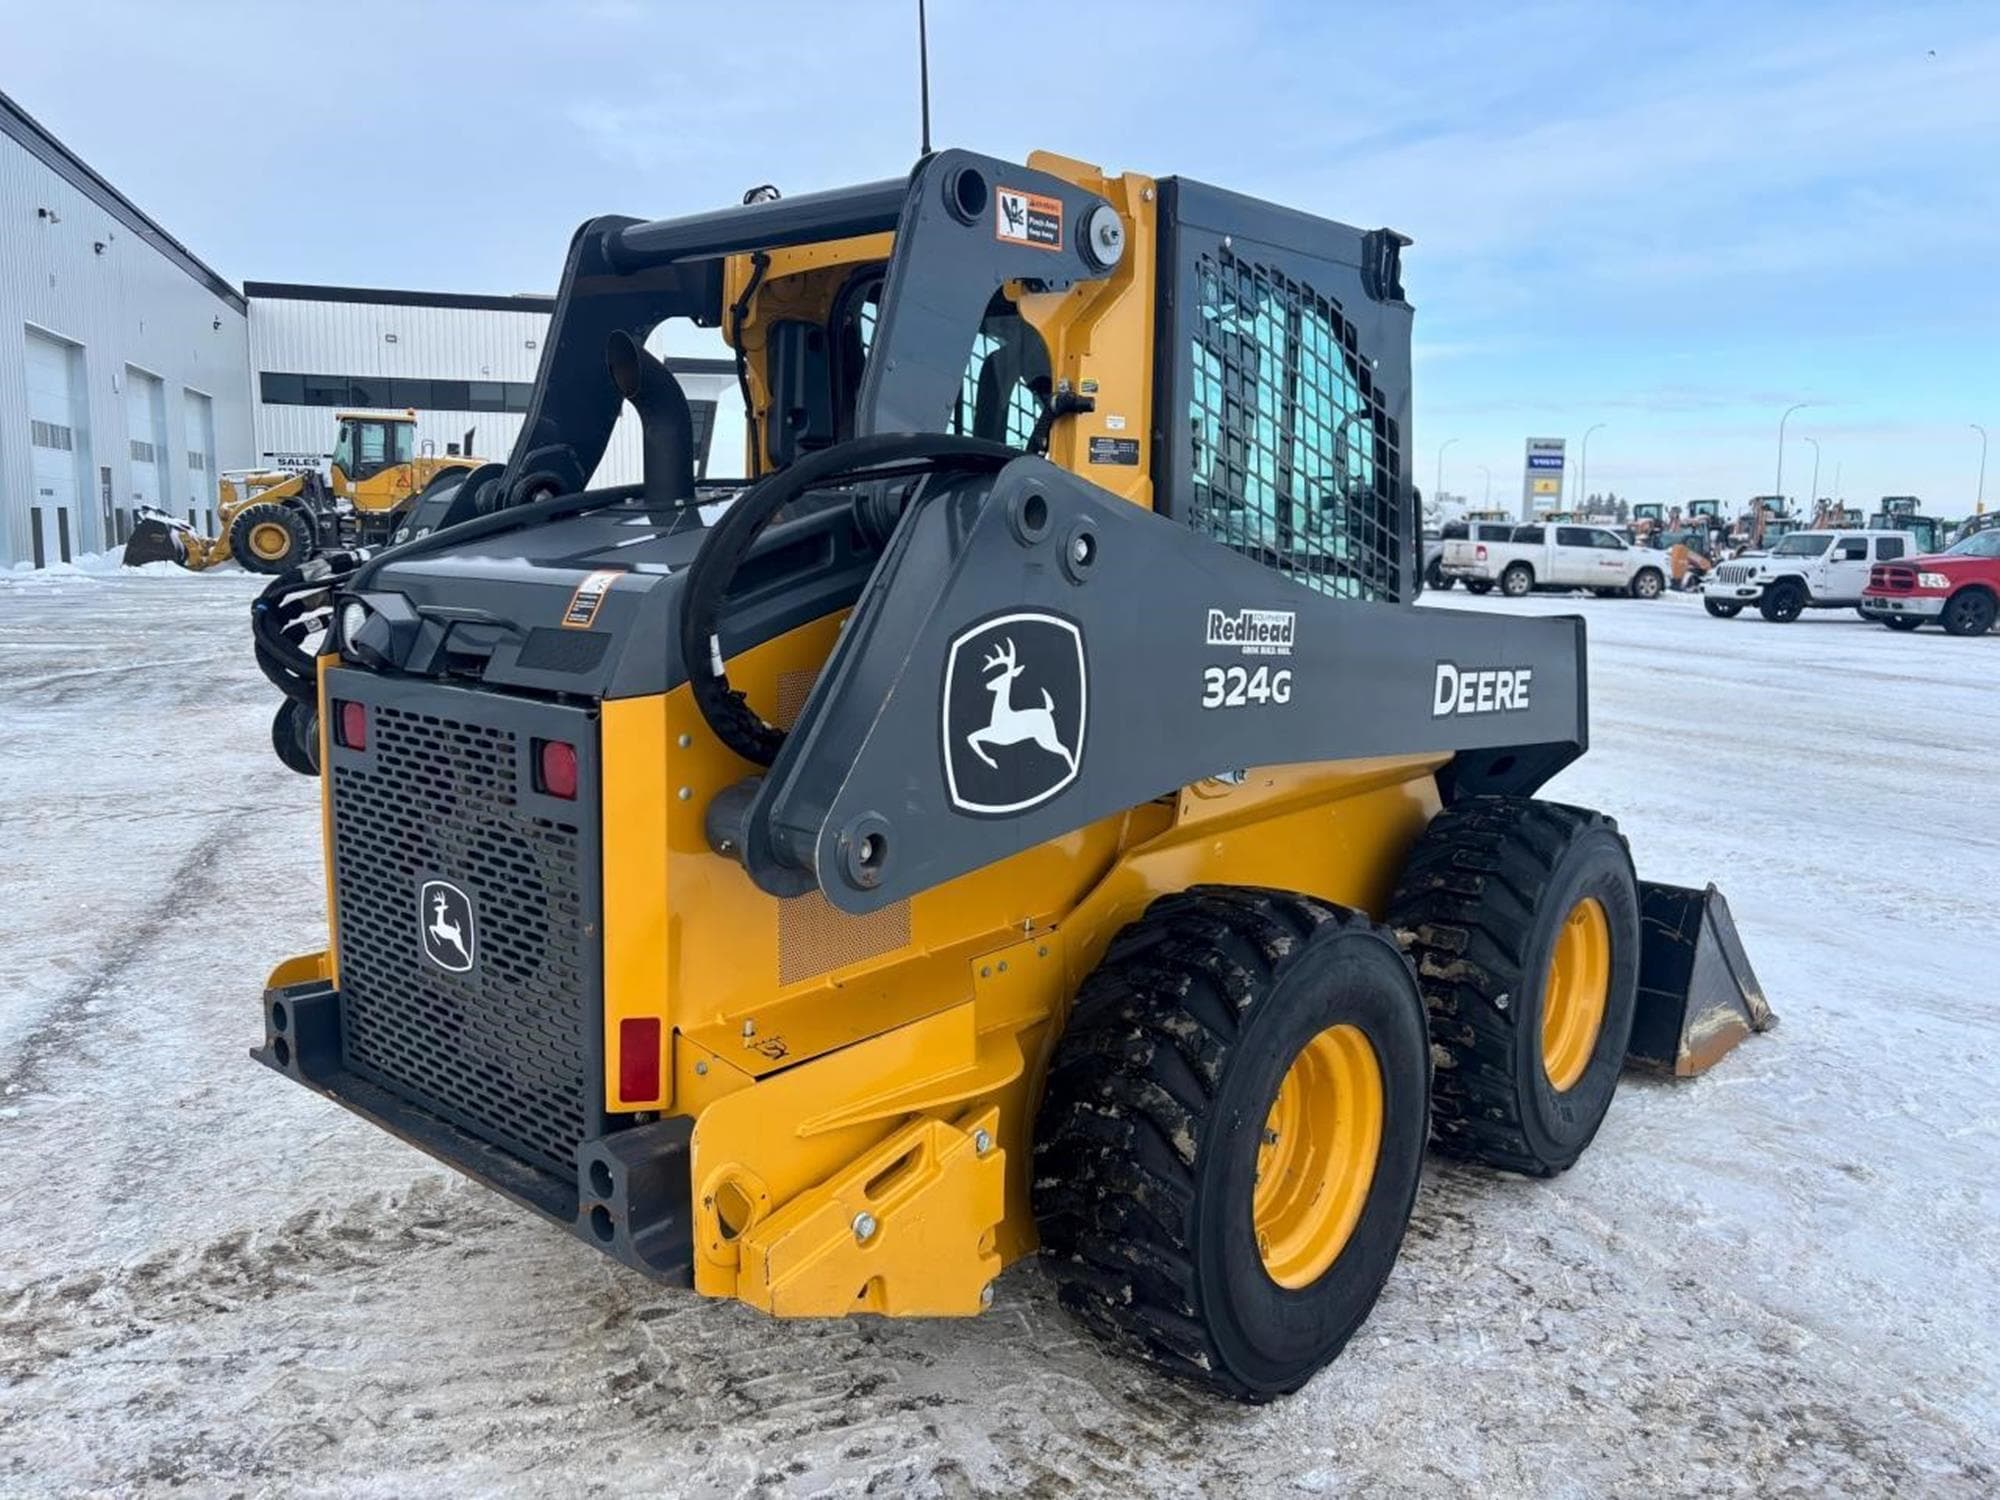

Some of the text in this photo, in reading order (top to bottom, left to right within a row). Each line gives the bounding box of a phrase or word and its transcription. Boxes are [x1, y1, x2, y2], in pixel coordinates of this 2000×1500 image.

[277, 458, 321, 466] SALES
[1209, 612, 1293, 642] Redhead
[1202, 666, 1292, 708] 324G
[1433, 664, 1532, 715] DEERE
